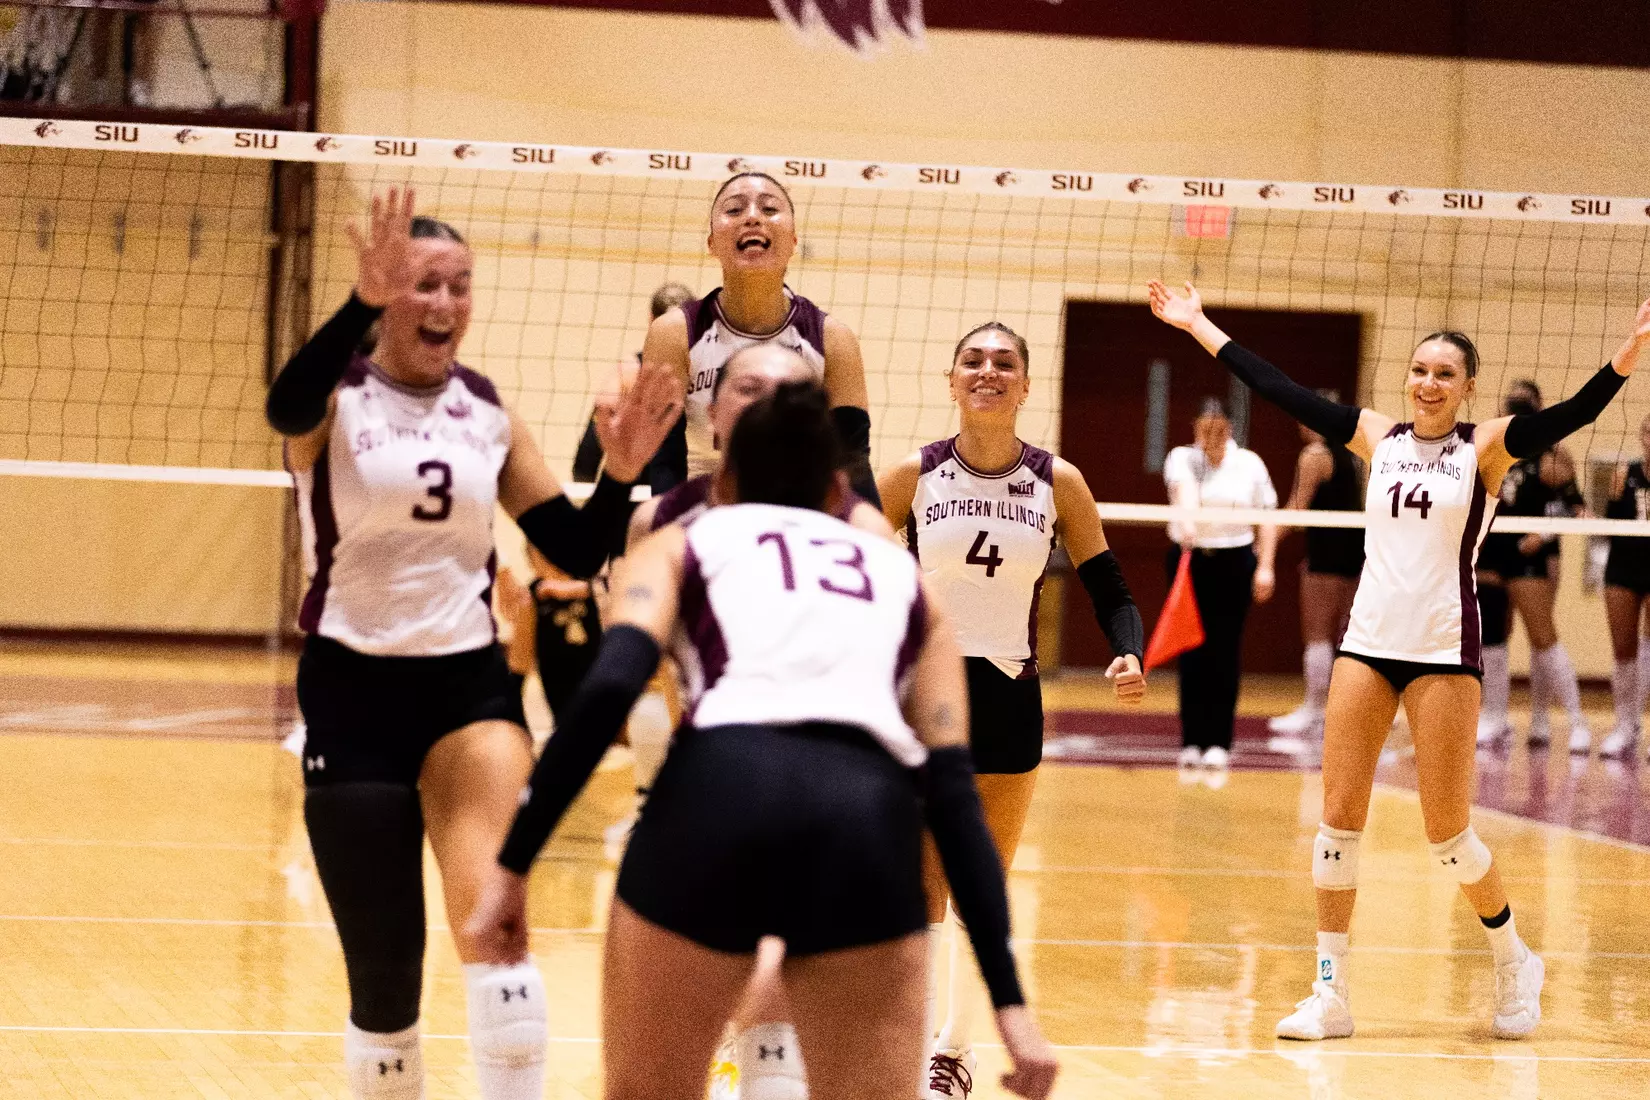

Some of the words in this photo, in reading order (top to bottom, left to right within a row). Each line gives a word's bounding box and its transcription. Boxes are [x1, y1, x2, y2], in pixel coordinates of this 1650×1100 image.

[95, 125, 140, 143] SIU
[235, 132, 279, 149] SIU
[374, 140, 417, 157] SIU
[512, 147, 555, 163] SIU
[649, 154, 691, 170] SIU
[785, 161, 826, 178] SIU
[919, 168, 960, 185] SIU
[1052, 174, 1093, 191] SIU
[1183, 181, 1224, 198] SIU
[1314, 187, 1355, 203] SIU
[1443, 193, 1484, 210] SIU
[1571, 199, 1611, 216] SIU
[411, 460, 453, 522] 3
[925, 499, 992, 526] SOUTHERN
[996, 500, 1046, 534] ILLINOIS
[1387, 481, 1433, 519] 14
[757, 531, 875, 602] 13
[965, 530, 1004, 578] 4
